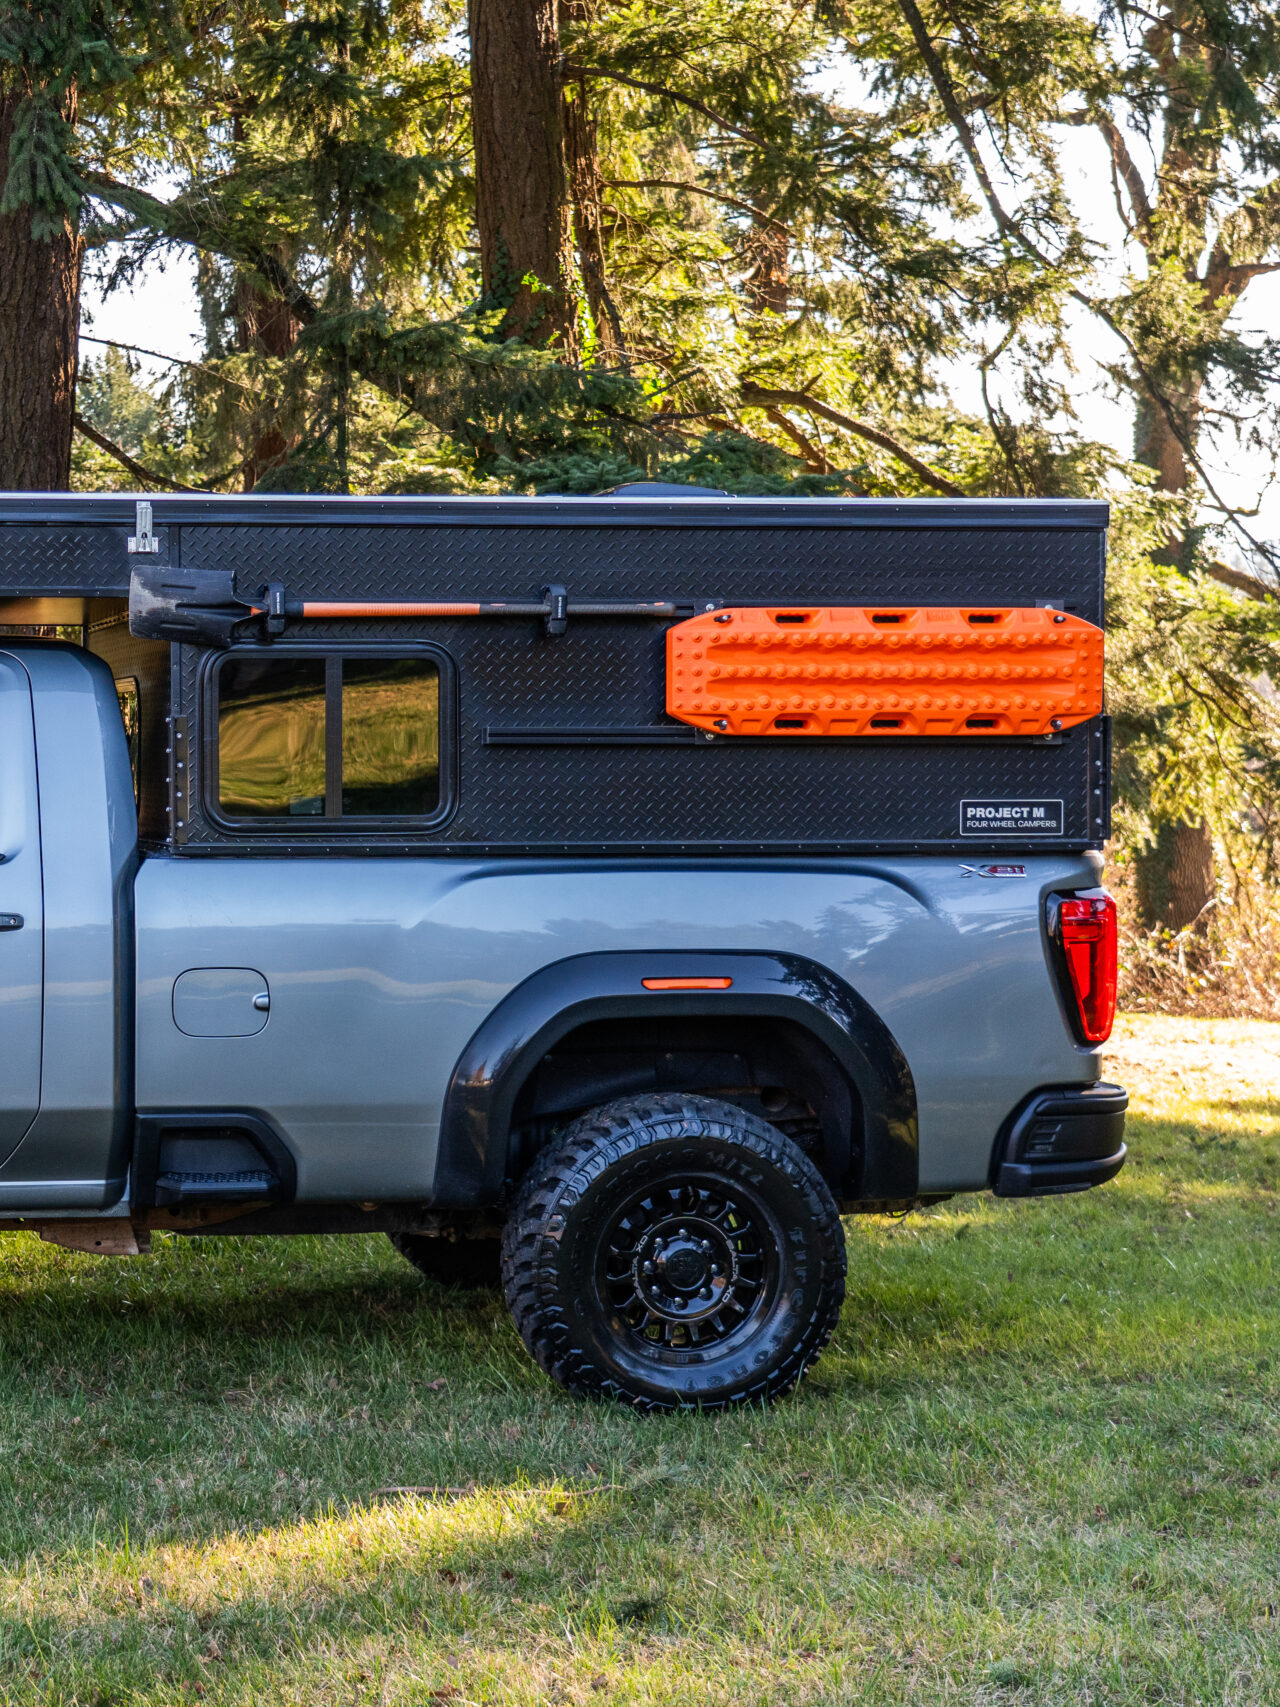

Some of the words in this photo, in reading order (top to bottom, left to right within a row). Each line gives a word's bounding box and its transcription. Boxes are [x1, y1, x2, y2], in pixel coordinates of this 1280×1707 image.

[967, 807, 1029, 818] PROJECT
[1032, 807, 1045, 818] M
[966, 820, 988, 828] FOUR
[989, 820, 1017, 828] WHEEL
[1017, 820, 1057, 828] CAMPERS
